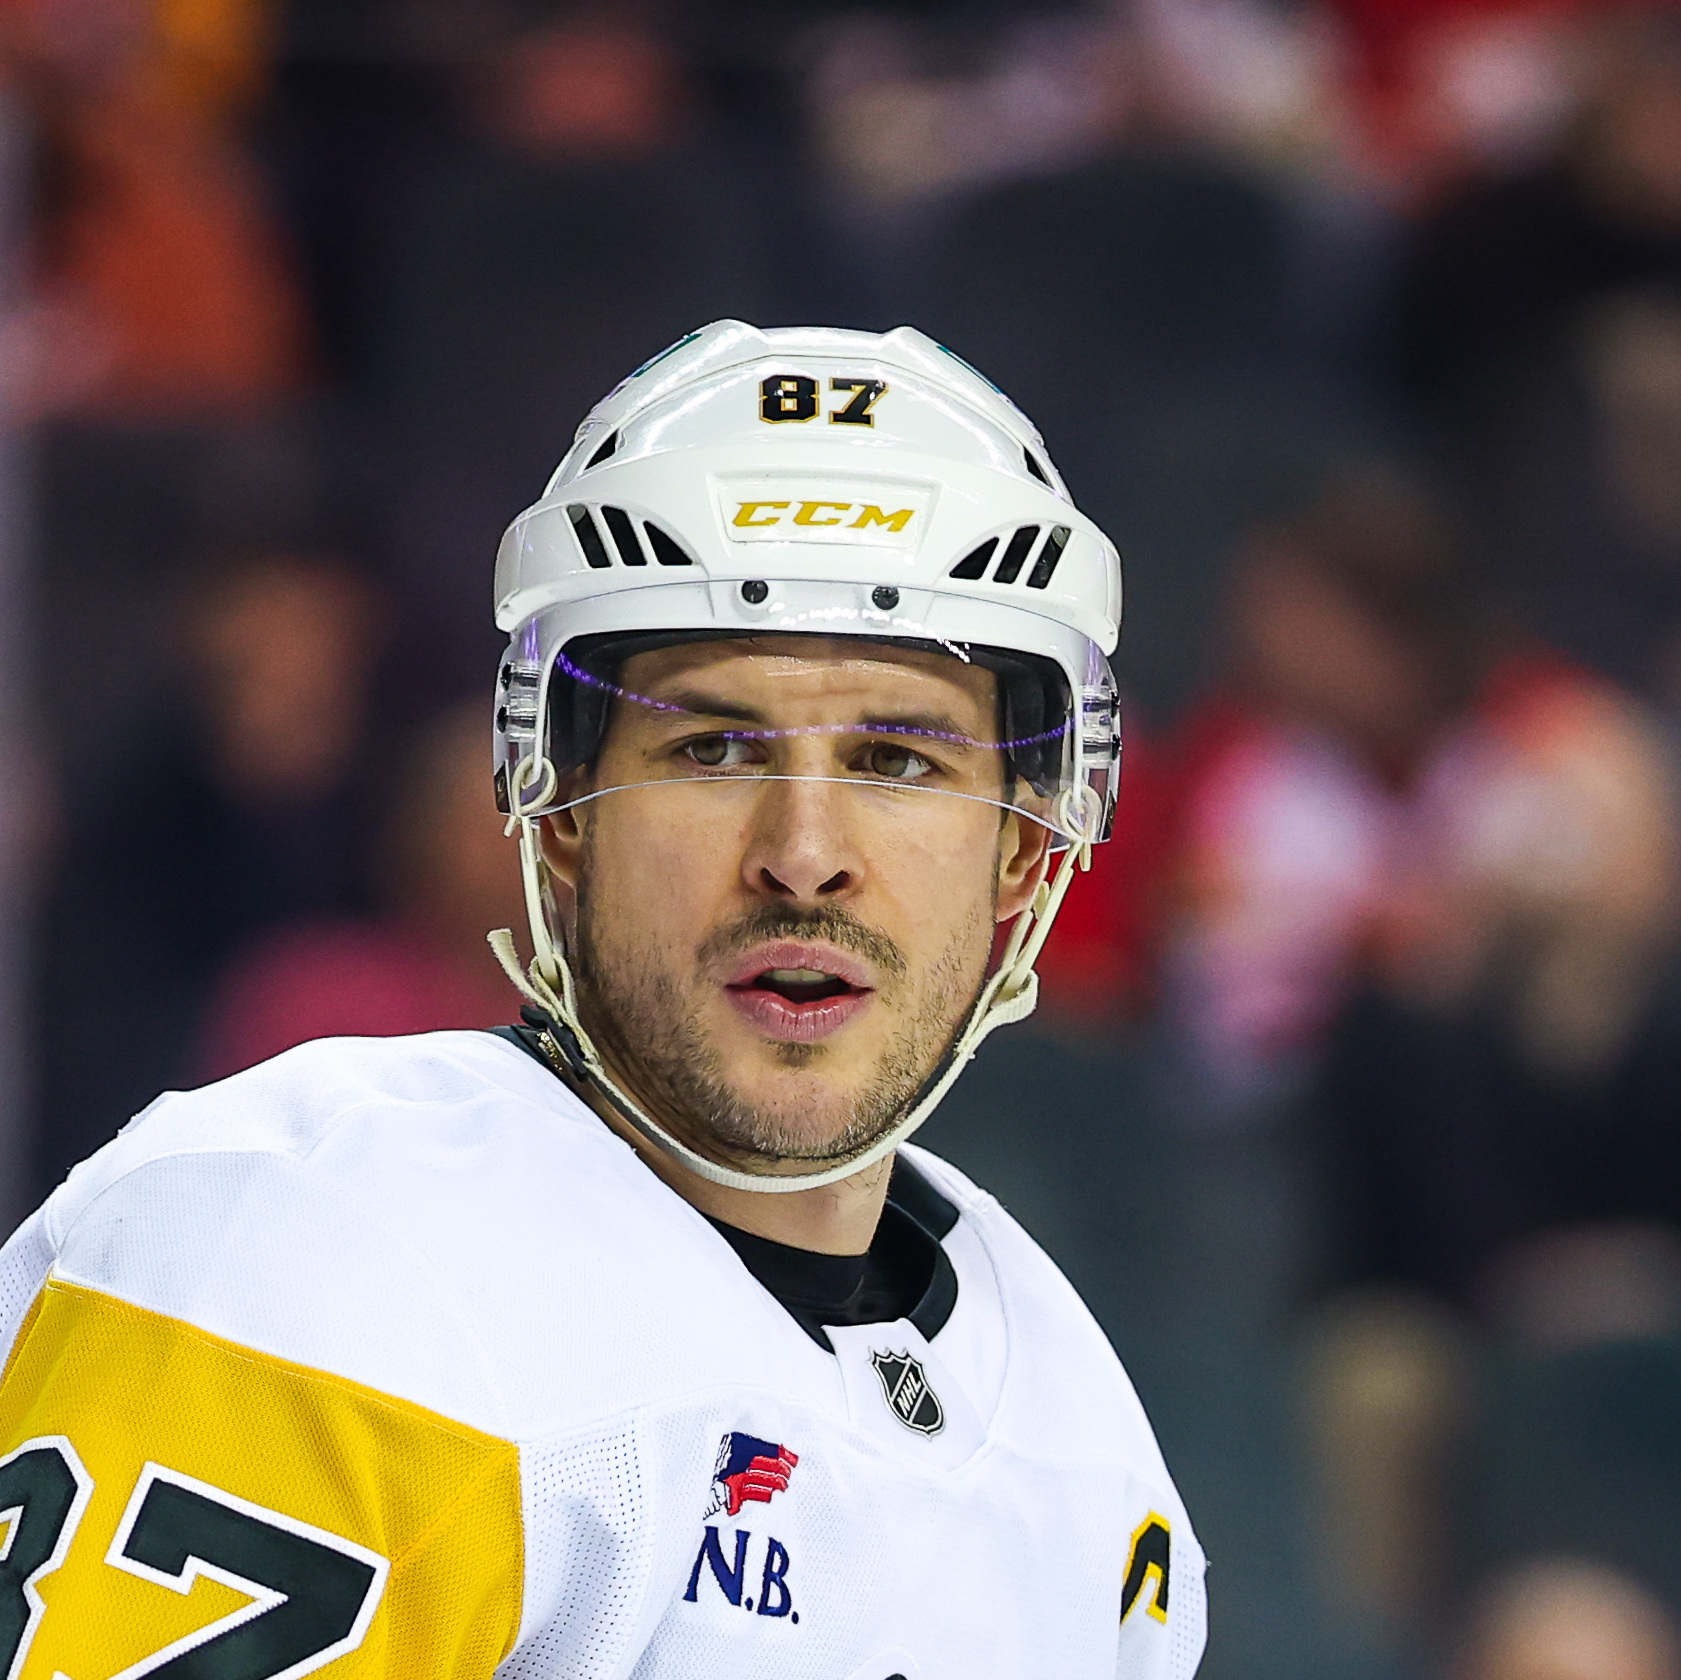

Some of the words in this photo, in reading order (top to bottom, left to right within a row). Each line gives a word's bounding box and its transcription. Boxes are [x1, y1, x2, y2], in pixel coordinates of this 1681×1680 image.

[759, 374, 888, 428] 87
[732, 500, 915, 532] CCM
[896, 1371, 922, 1418] NHL
[682, 1525, 800, 1625] N.B.
